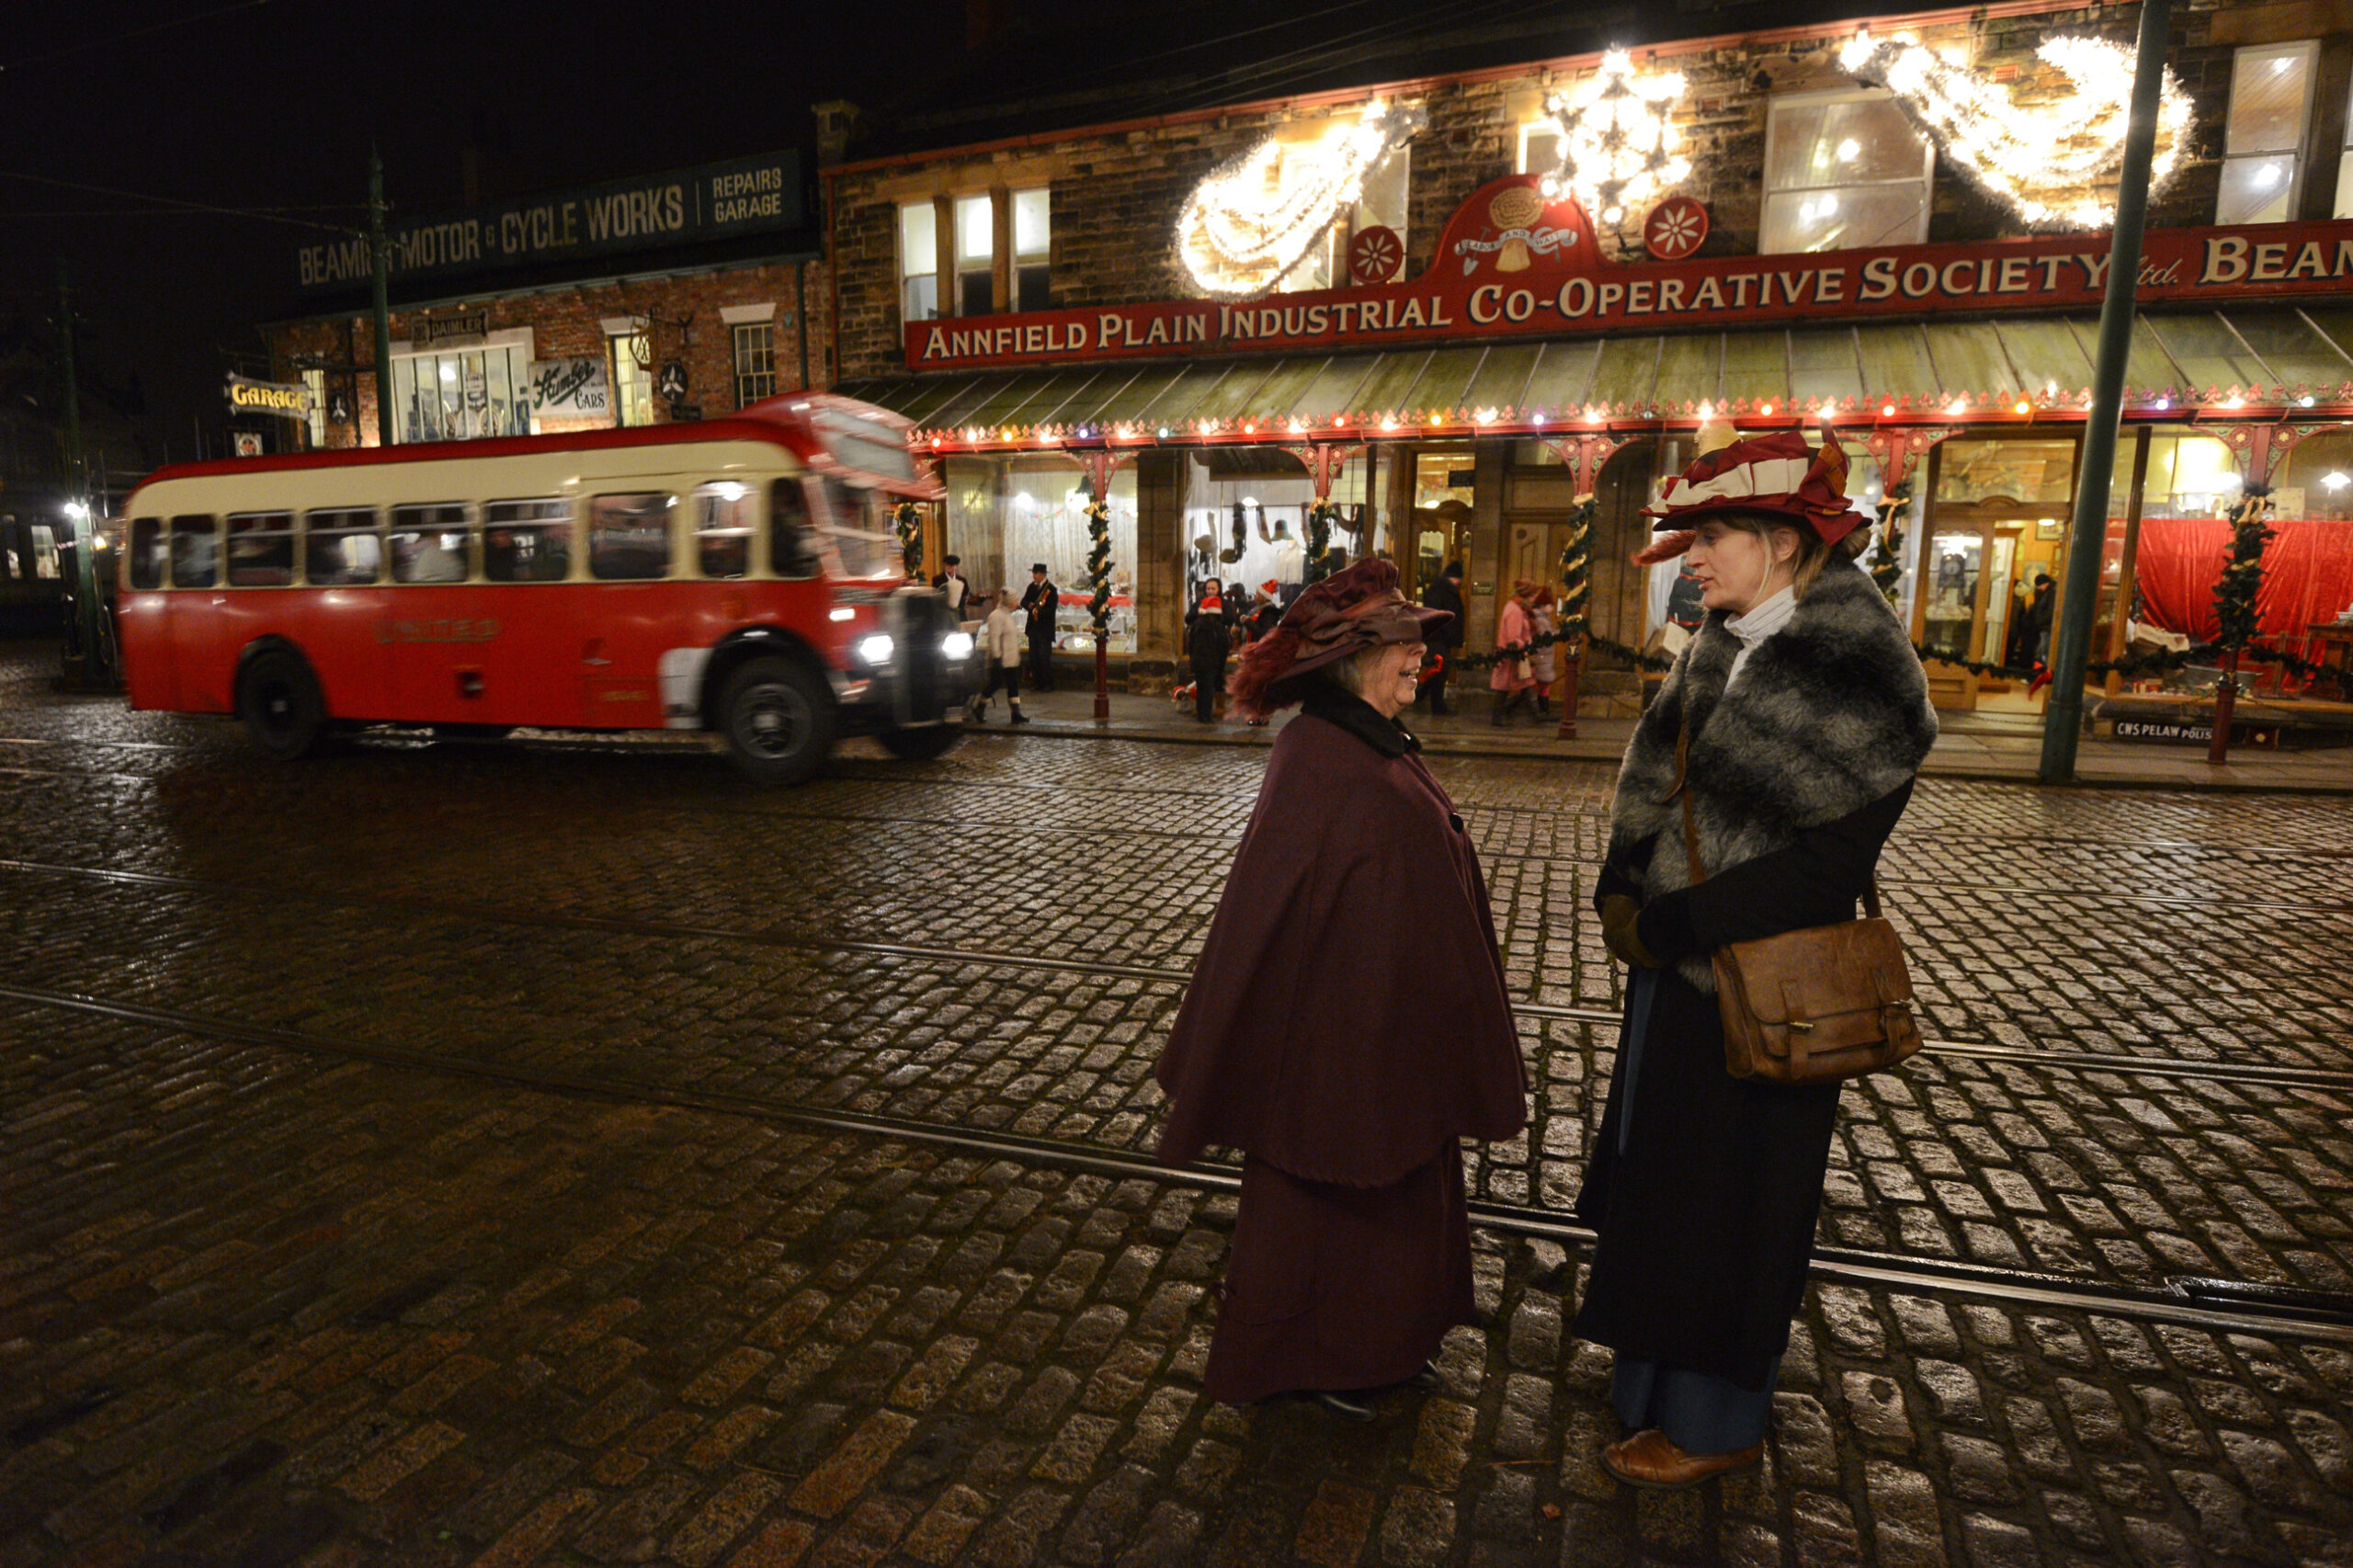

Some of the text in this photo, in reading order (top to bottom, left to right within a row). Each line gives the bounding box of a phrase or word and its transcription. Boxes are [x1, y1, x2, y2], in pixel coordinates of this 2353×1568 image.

[712, 167, 781, 199] REPAIRS
[714, 193, 781, 223] GARAGE
[398, 220, 481, 270] MOTOR
[501, 201, 578, 255] CYCLE
[585, 185, 684, 242] WORKS
[1467, 230, 1560, 251] LABOR AND WAIT
[922, 323, 1087, 360] ANNFIELD
[1097, 313, 1207, 349] PLAIN
[1218, 296, 1453, 340] INDUSTRIAL
[1469, 267, 1846, 324] CO-OPERATIVE
[1858, 252, 2111, 300] SOCIETY
[2136, 256, 2184, 285] td.
[432, 317, 481, 336] DAIMLER
[232, 383, 308, 412] GARAGE
[532, 360, 596, 410] Humber
[574, 389, 605, 409] CARS
[2117, 722, 2140, 736] CWS
[2142, 724, 2180, 737] PELAW
